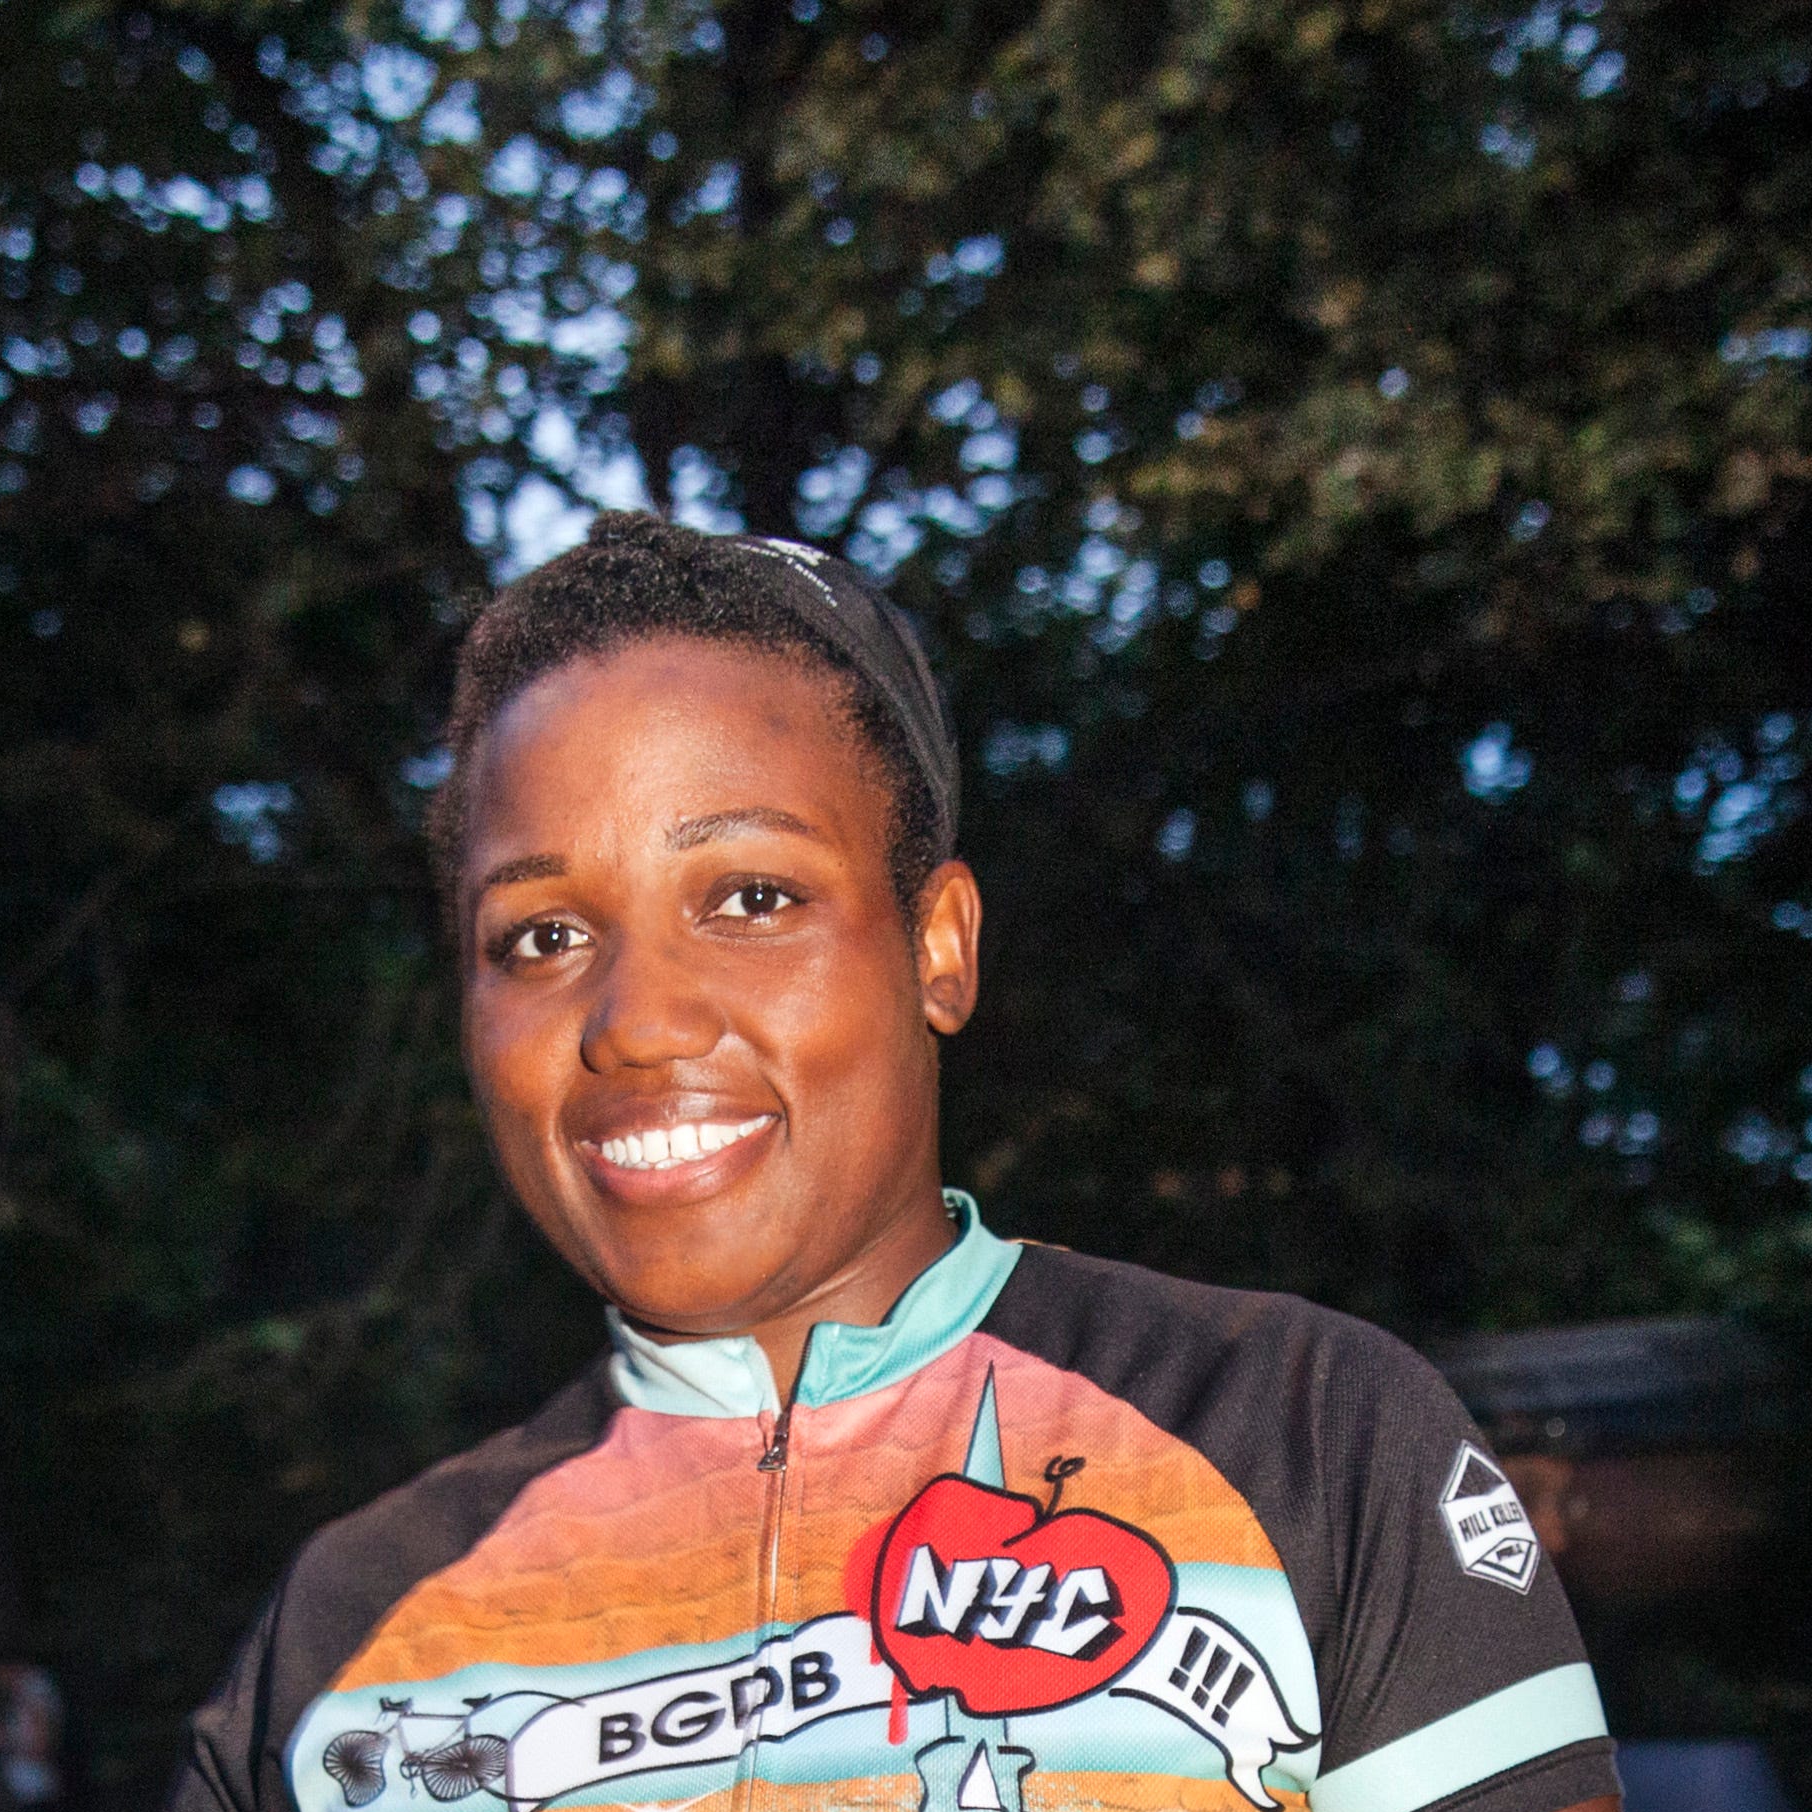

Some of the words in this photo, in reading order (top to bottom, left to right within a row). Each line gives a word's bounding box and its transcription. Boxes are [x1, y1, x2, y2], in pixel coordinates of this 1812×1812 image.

[1458, 1510, 1492, 1543] HILL
[598, 1650, 841, 1765] BGDB
[895, 1543, 1126, 1661] NYC
